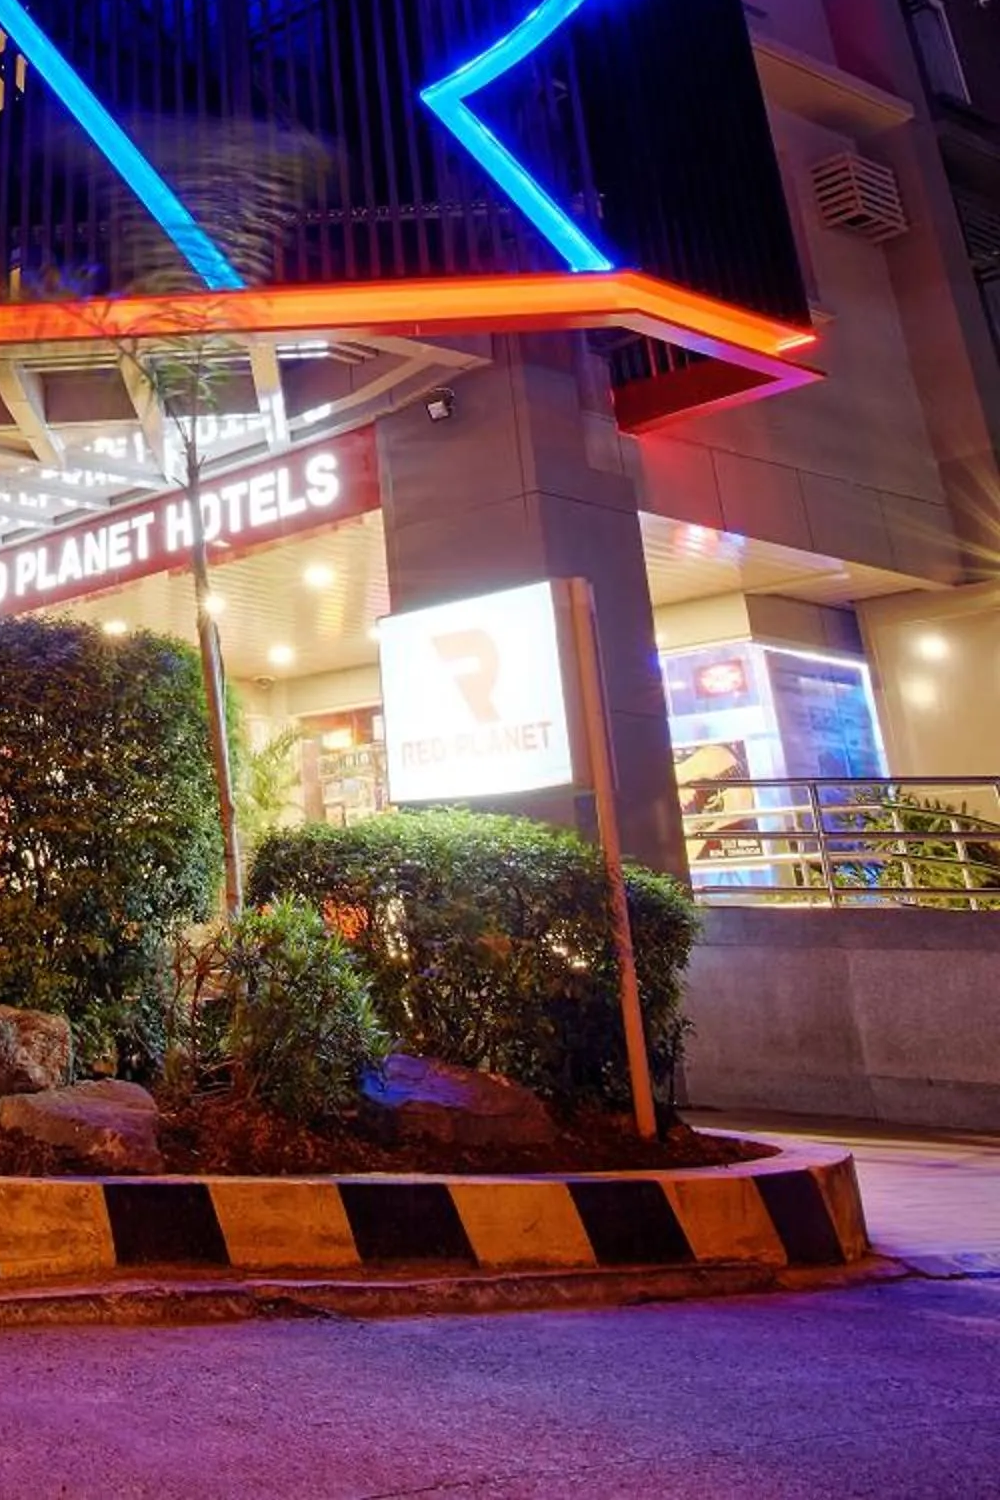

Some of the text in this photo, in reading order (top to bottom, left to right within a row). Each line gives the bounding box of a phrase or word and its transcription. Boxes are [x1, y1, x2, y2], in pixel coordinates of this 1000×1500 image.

[15, 512, 155, 596] PLANET
[165, 453, 340, 551] HOTELS
[430, 627, 504, 725] R
[401, 720, 553, 769] RED PLANET
